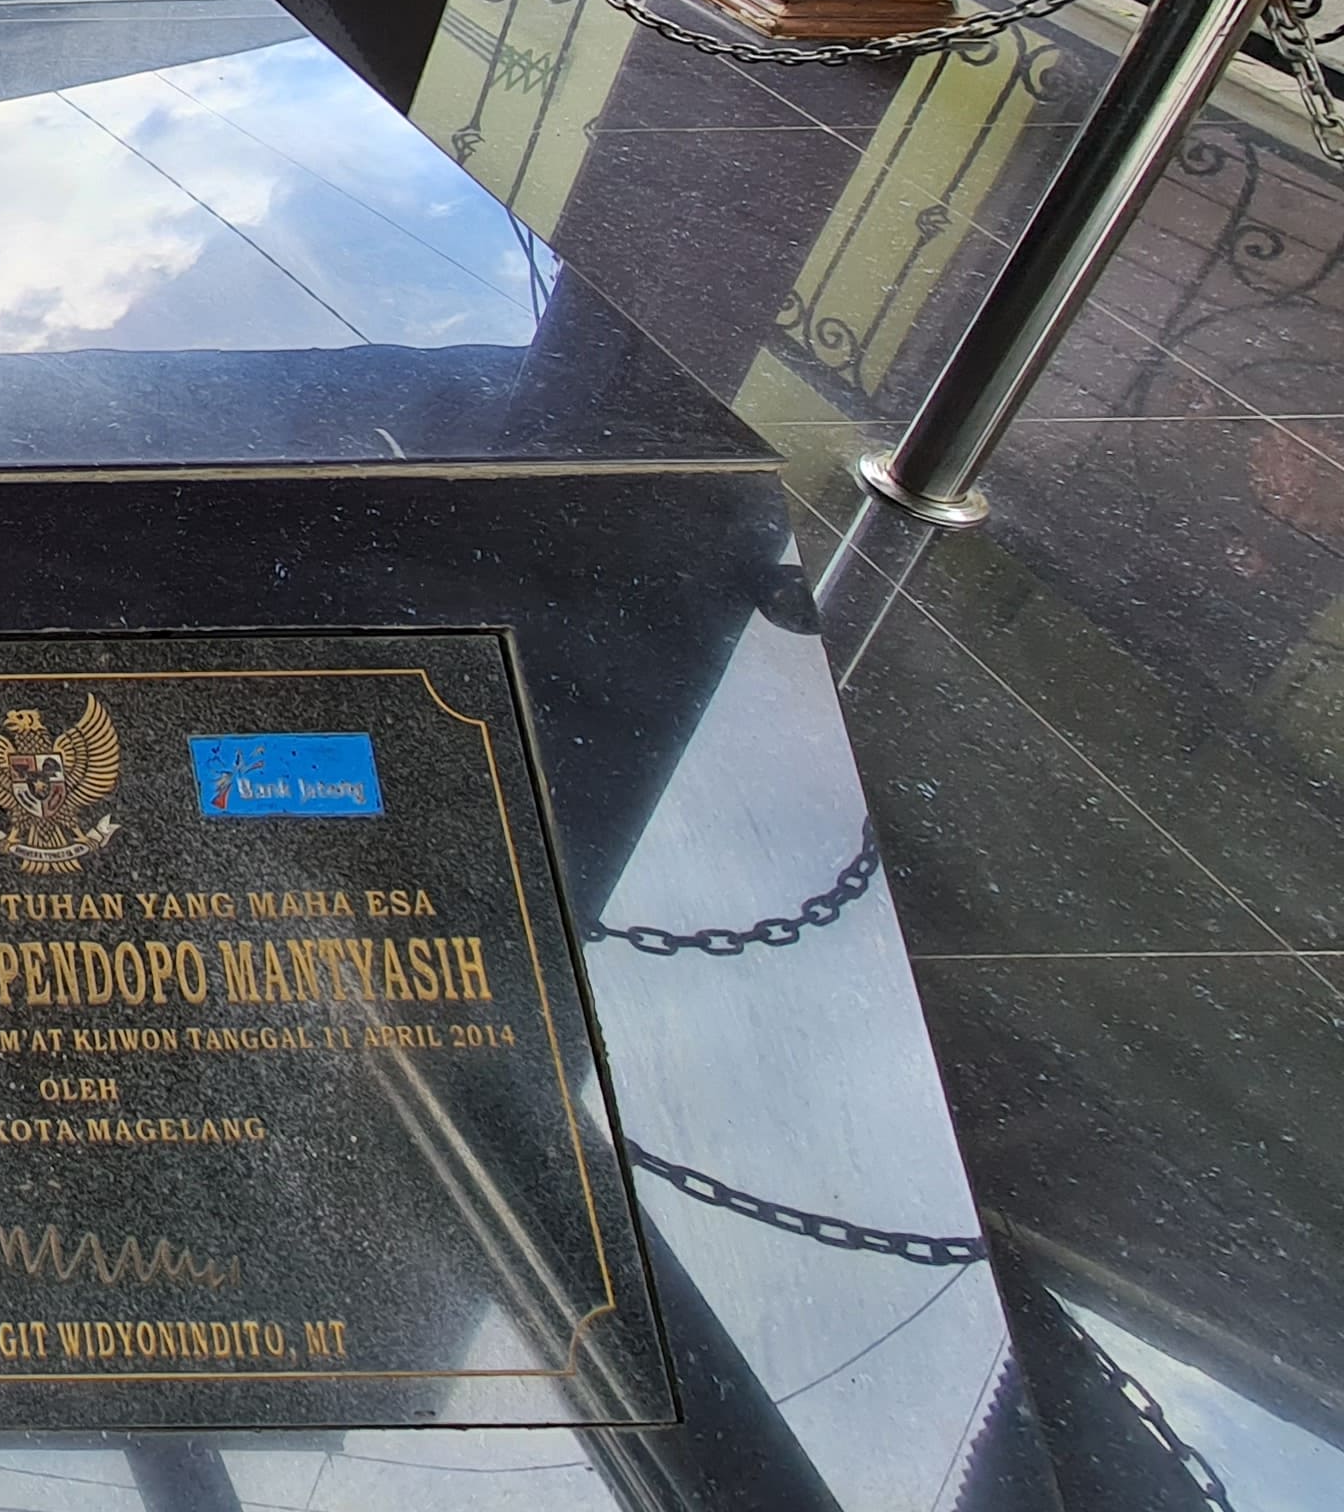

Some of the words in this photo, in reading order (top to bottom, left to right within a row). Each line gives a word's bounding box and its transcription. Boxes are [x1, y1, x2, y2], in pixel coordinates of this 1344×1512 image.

[236, 776, 291, 800] Bank
[1, 892, 123, 922] TUHAN
[136, 891, 235, 920] YANG
[248, 890, 355, 919] MAHA
[367, 889, 436, 918] ESA
[218, 936, 493, 1004] MANTYASIH
[74, 1027, 178, 1052] KLIWON
[187, 1026, 313, 1052] TANGGAL
[323, 1026, 353, 1050] 11
[363, 1024, 443, 1049] APRIL
[452, 1023, 516, 1048] 2014
[39, 1077, 120, 1103] OLEH
[86, 1117, 267, 1144] MAGELANG
[305, 1319, 347, 1357] MT
